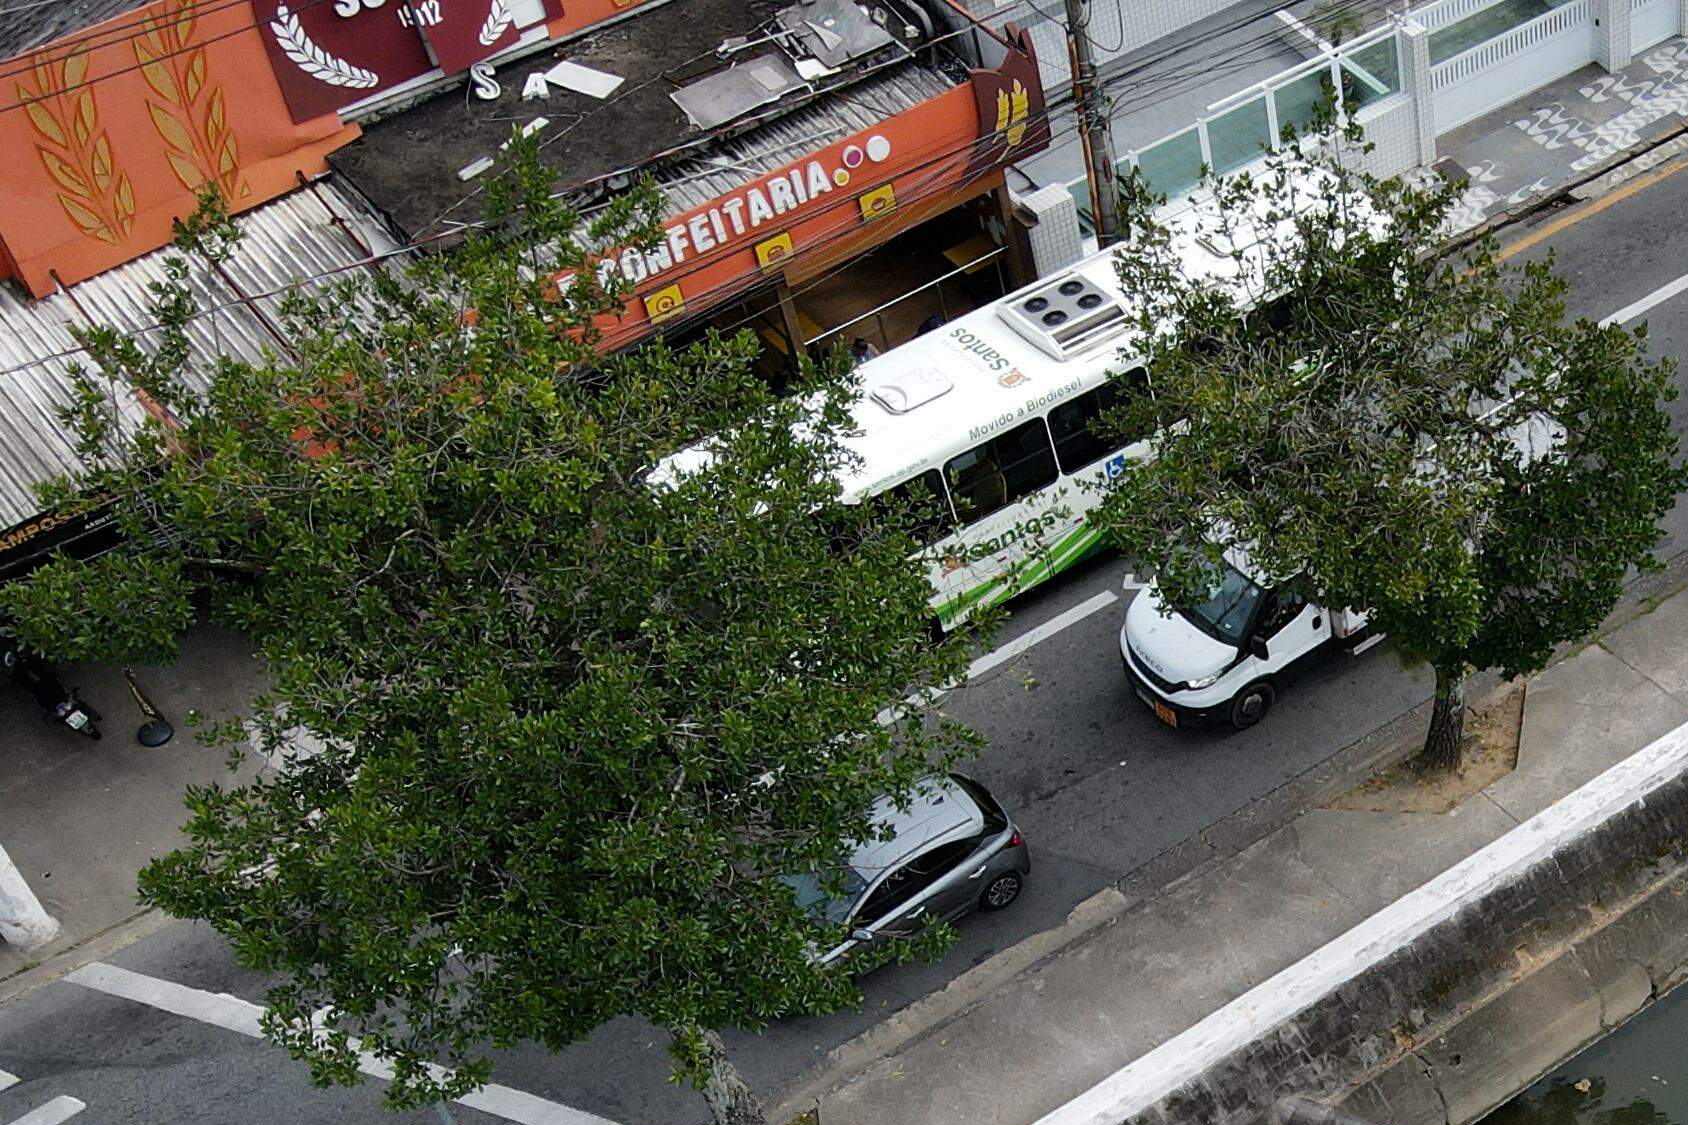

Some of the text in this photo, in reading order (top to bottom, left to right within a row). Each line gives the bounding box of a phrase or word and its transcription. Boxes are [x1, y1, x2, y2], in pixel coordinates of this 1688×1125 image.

[597, 160, 833, 295] CONFEITARIA
[950, 328, 1010, 371] Santos
[968, 376, 1082, 441] Movido a Biodiesel
